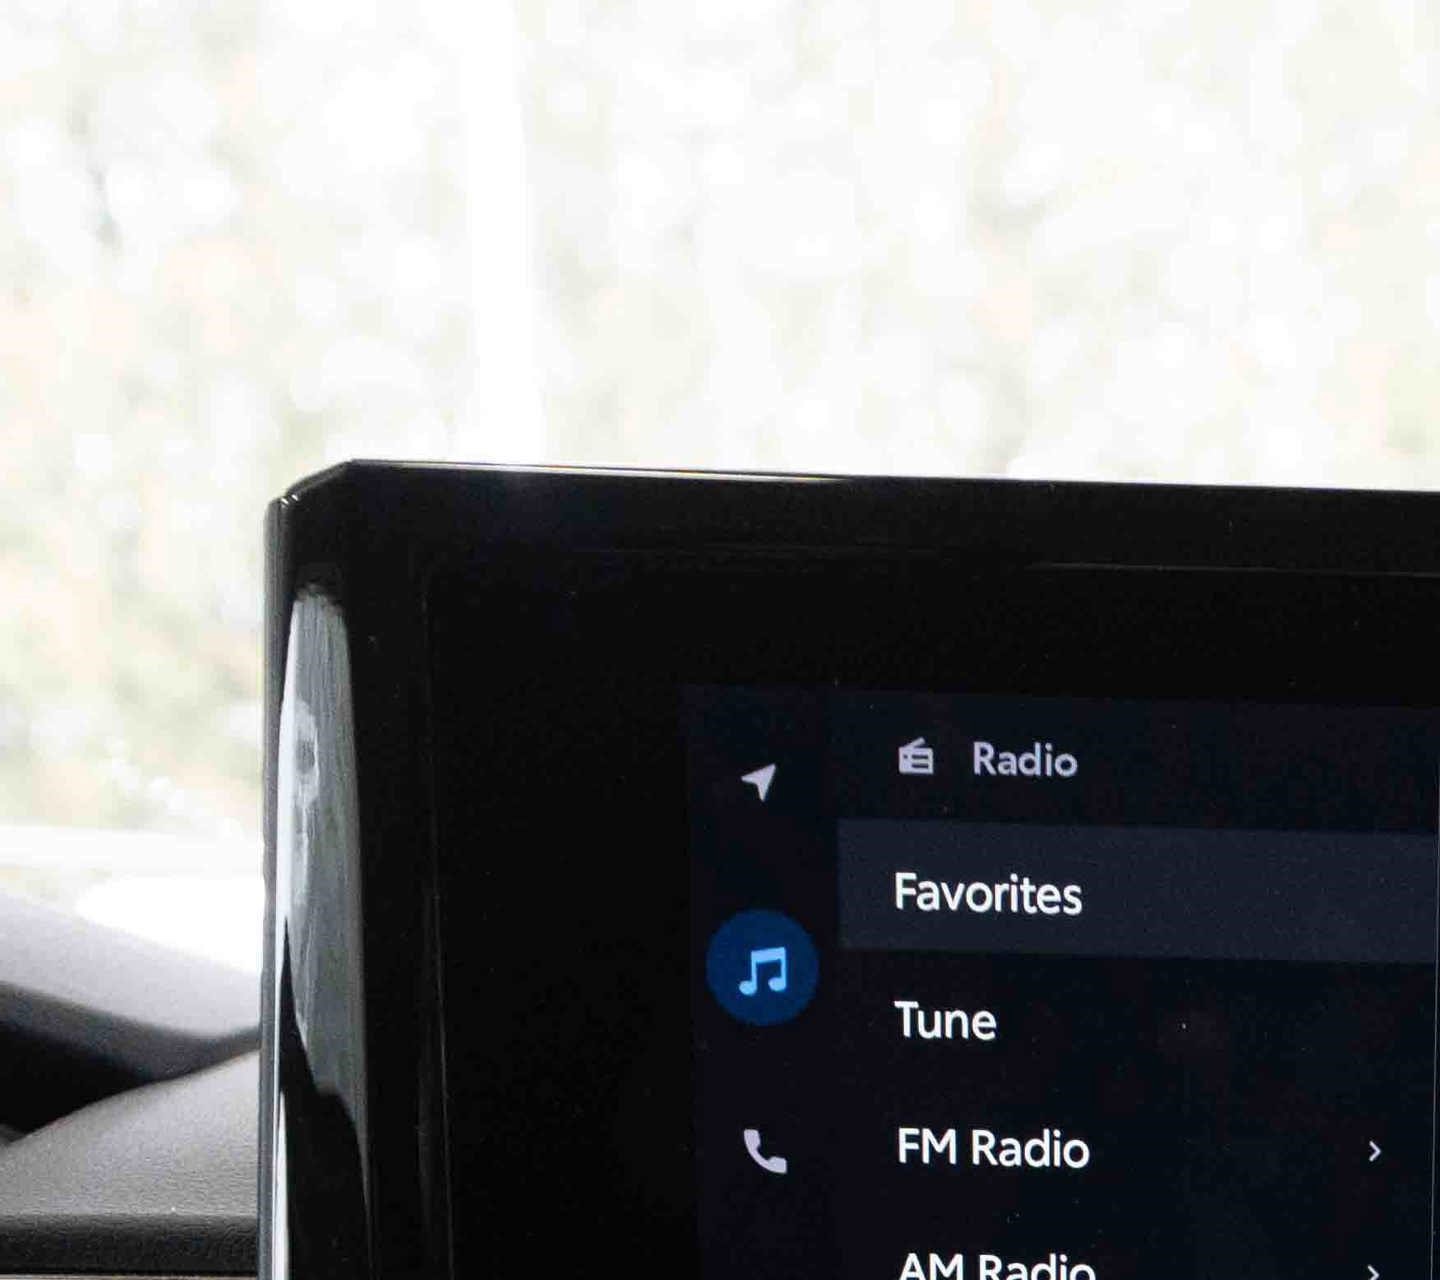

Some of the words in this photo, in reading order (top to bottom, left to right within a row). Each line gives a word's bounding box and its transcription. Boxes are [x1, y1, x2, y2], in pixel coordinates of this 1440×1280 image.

[973, 741, 1078, 778] Radio
[895, 871, 1083, 916] Favorites
[893, 1000, 997, 1041] Tune
[898, 1127, 957, 1165] FM
[971, 1128, 1091, 1169] Radio
